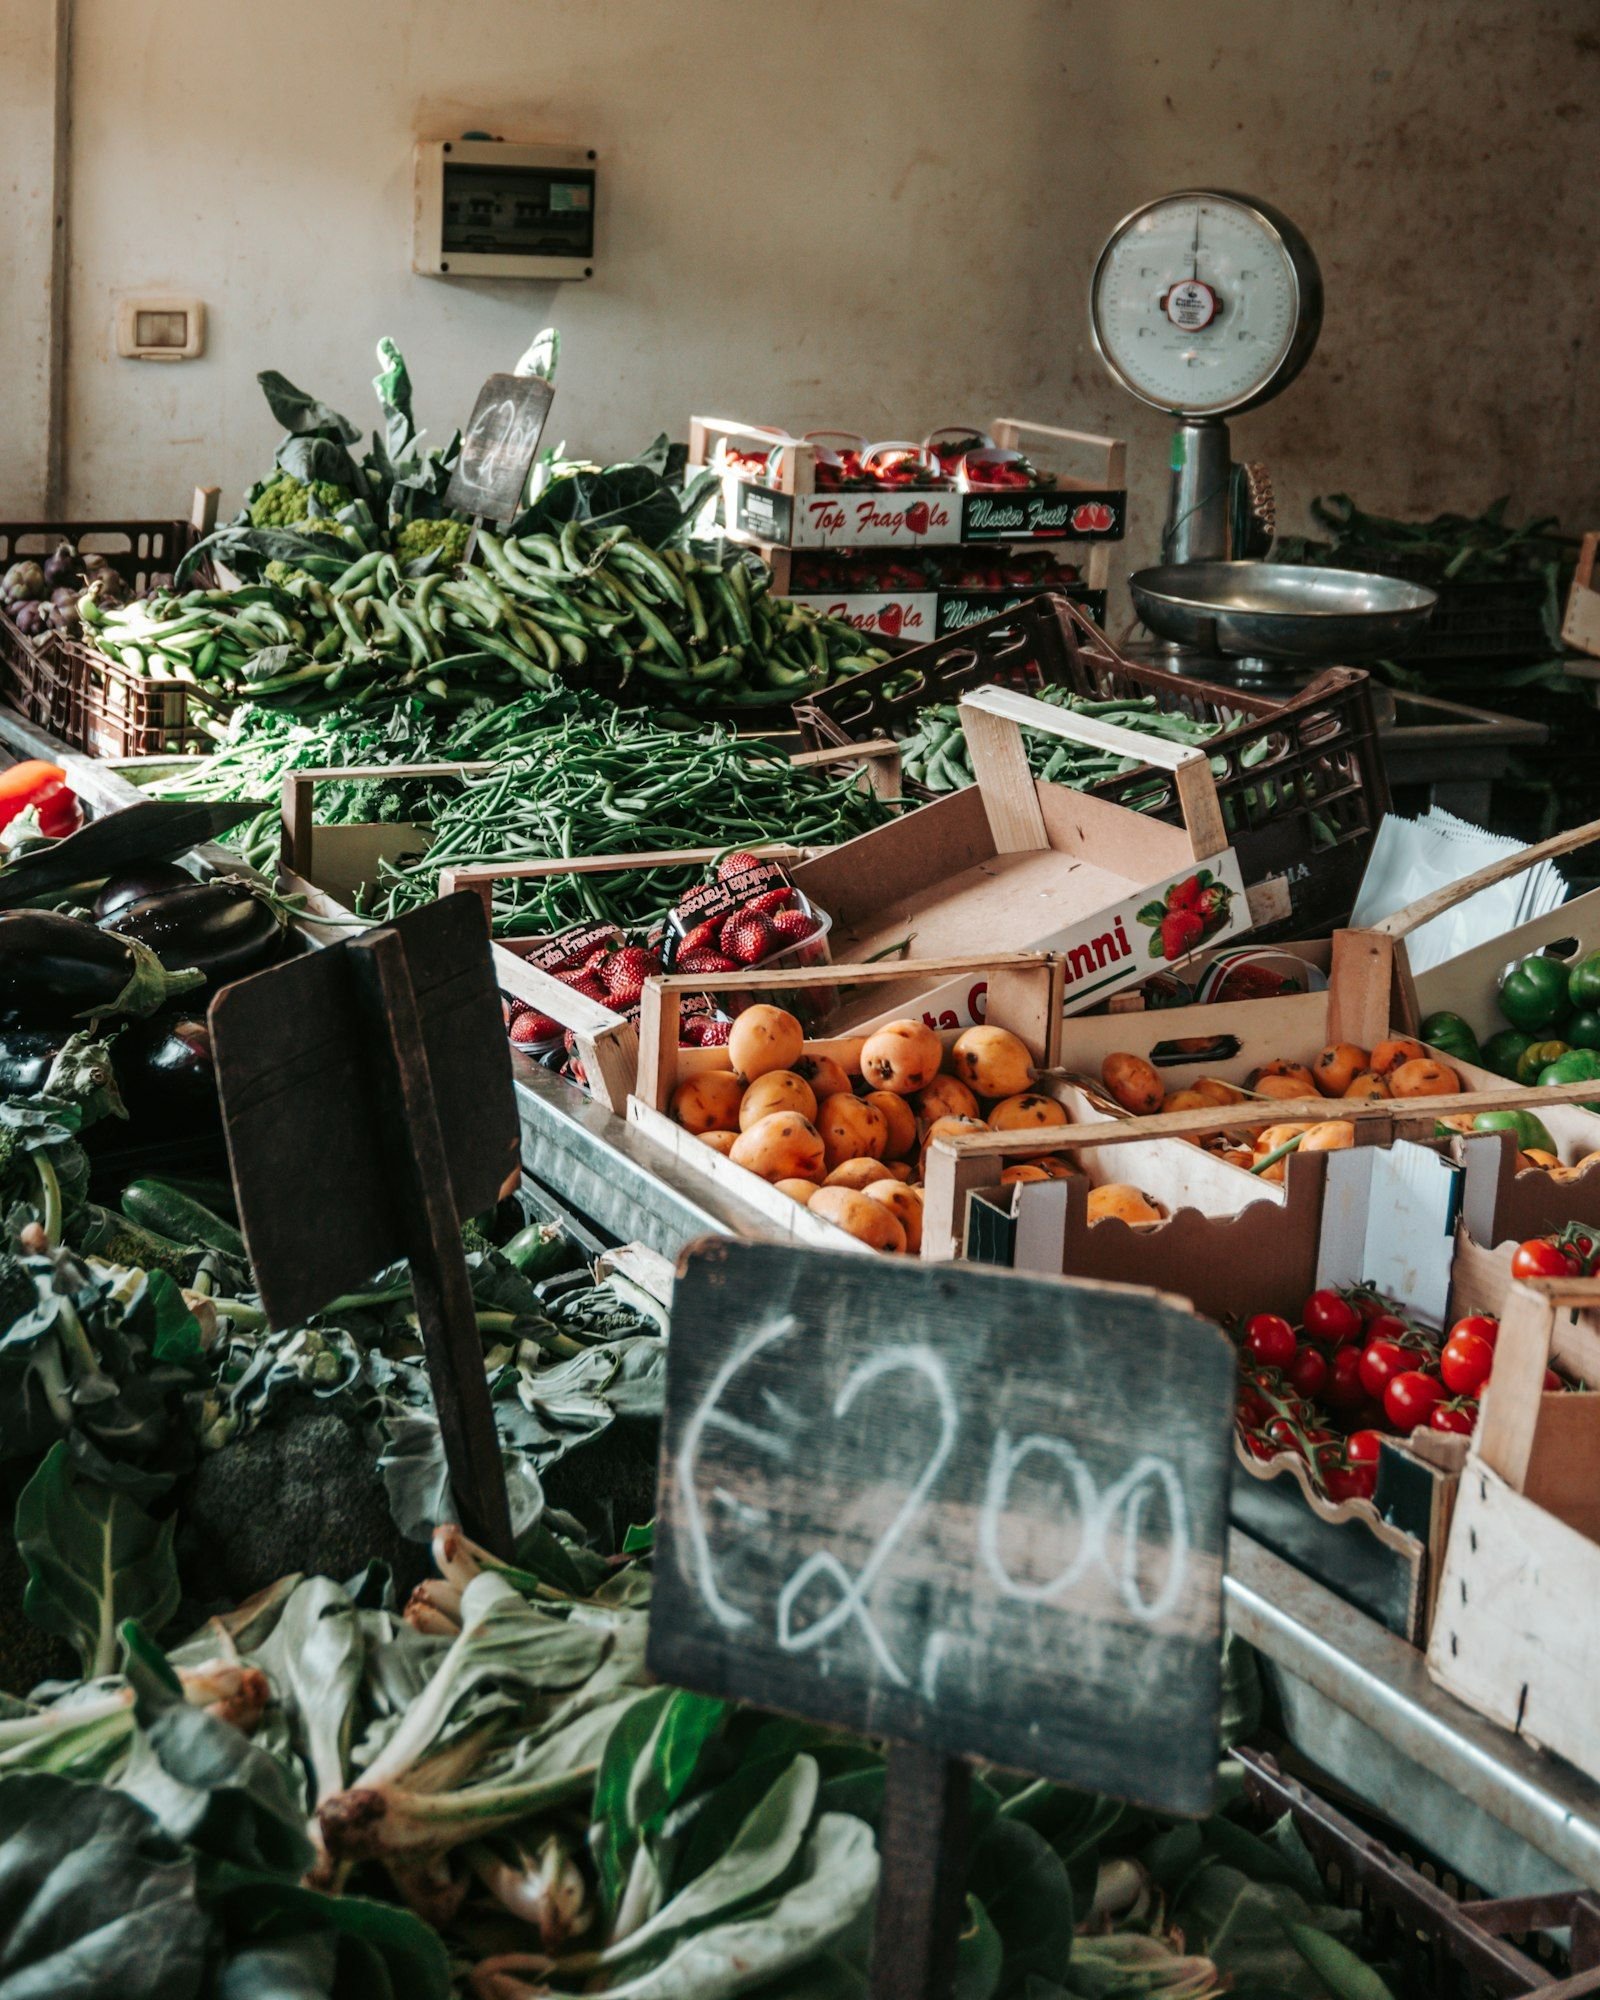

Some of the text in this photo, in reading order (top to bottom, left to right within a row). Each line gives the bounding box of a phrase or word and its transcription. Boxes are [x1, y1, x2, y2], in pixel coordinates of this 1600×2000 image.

[808, 501, 846, 536] Top
[968, 498, 1068, 530] Master Fruit
